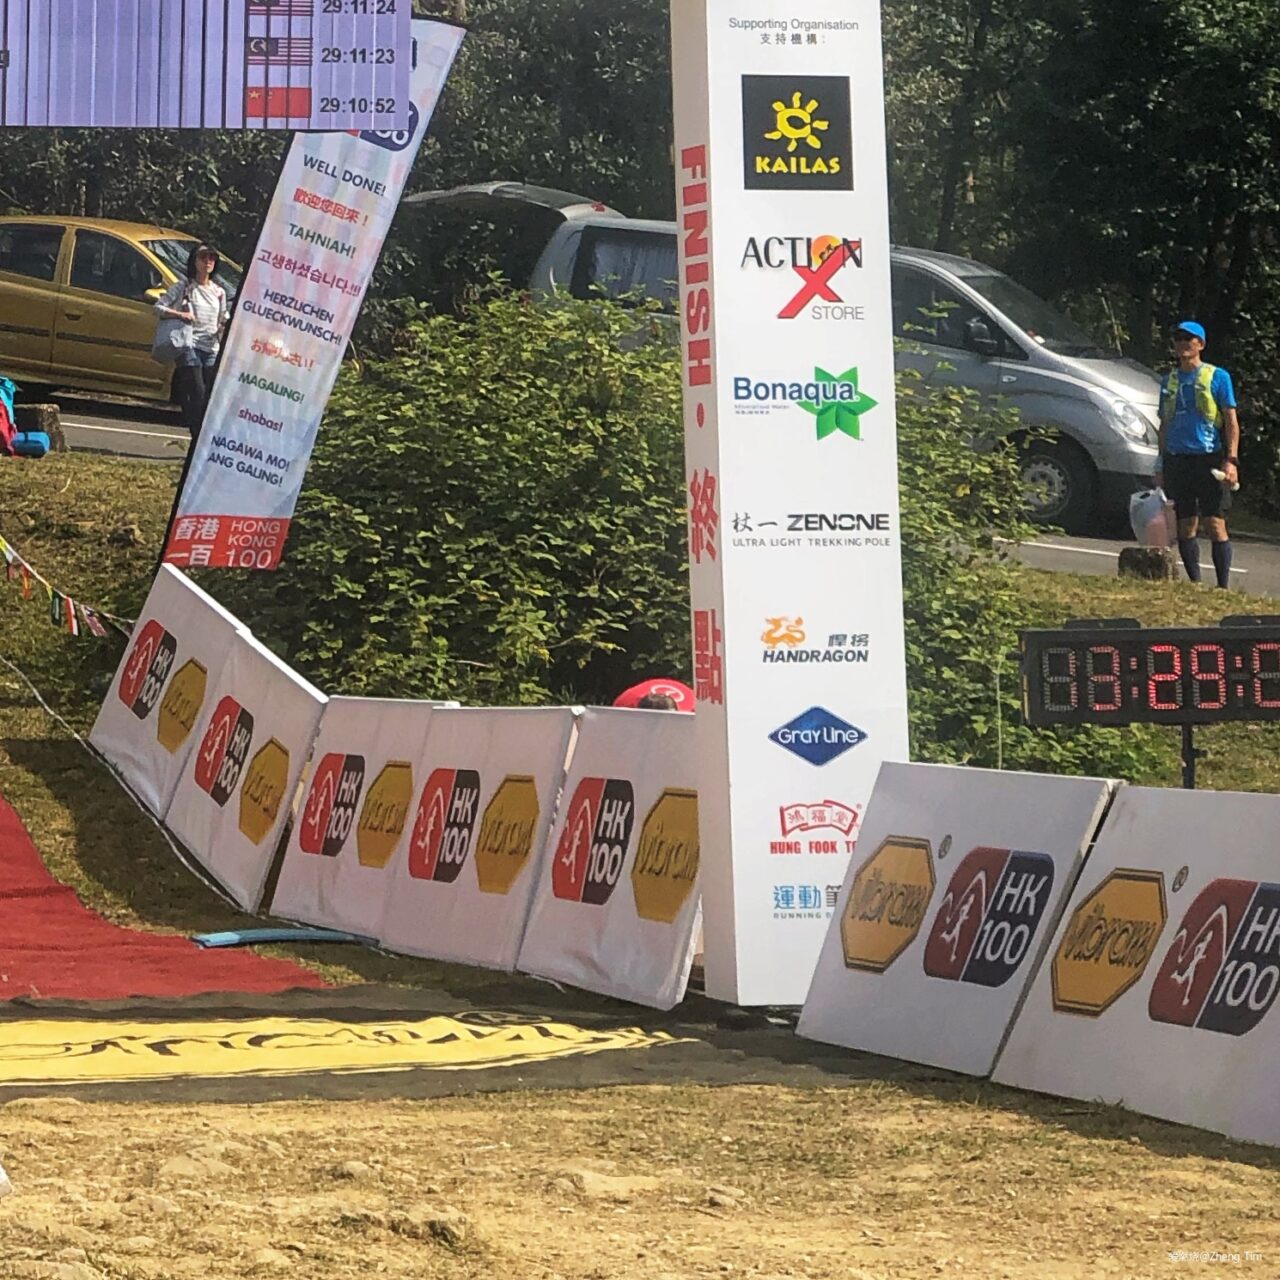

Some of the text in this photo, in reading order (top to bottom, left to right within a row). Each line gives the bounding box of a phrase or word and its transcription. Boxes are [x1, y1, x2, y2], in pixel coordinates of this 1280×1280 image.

[729, 17, 859, 32] Supporting Organisation
[321, 47, 395, 64] 29:11:23
[320, 96, 396, 113] 29:10:52
[303, 154, 387, 197] WELL DONE!
[755, 156, 840, 174] KAILAS
[289, 223, 357, 259] TAHNIAH!
[242, 300, 342, 346] GLUECKWUNSCH!
[263, 288, 334, 324] HERZLICHEN
[811, 305, 865, 320] STORE
[238, 372, 305, 405] MAGALING!
[733, 376, 856, 407] Bonaqua
[681, 144, 723, 706] FINISH 終點
[207, 452, 284, 488] ANG GALING!
[211, 435, 291, 473] NAGAWA MO!
[175, 518, 220, 541] 香港
[227, 534, 278, 548] KONG
[230, 520, 281, 533] HONG
[733, 537, 891, 547] ULTRA LIGHT TREKKING POLE
[167, 544, 214, 566] 一百
[225, 548, 273, 569] 100
[152, 646, 175, 676] HK
[762, 649, 869, 663] HANDRAGON
[140, 675, 161, 712] 100
[229, 719, 252, 755] HK
[218, 755, 239, 794] 100
[337, 770, 361, 803] HK
[330, 805, 353, 841] 100
[451, 787, 477, 824] HK
[599, 799, 631, 842] HK
[442, 827, 469, 866] 100
[770, 841, 802, 854] HUNG
[809, 841, 838, 854] FOOK
[588, 845, 622, 886] 100
[996, 871, 1049, 917] HK
[975, 920, 1030, 966] 100
[1214, 960, 1280, 1011] 100
